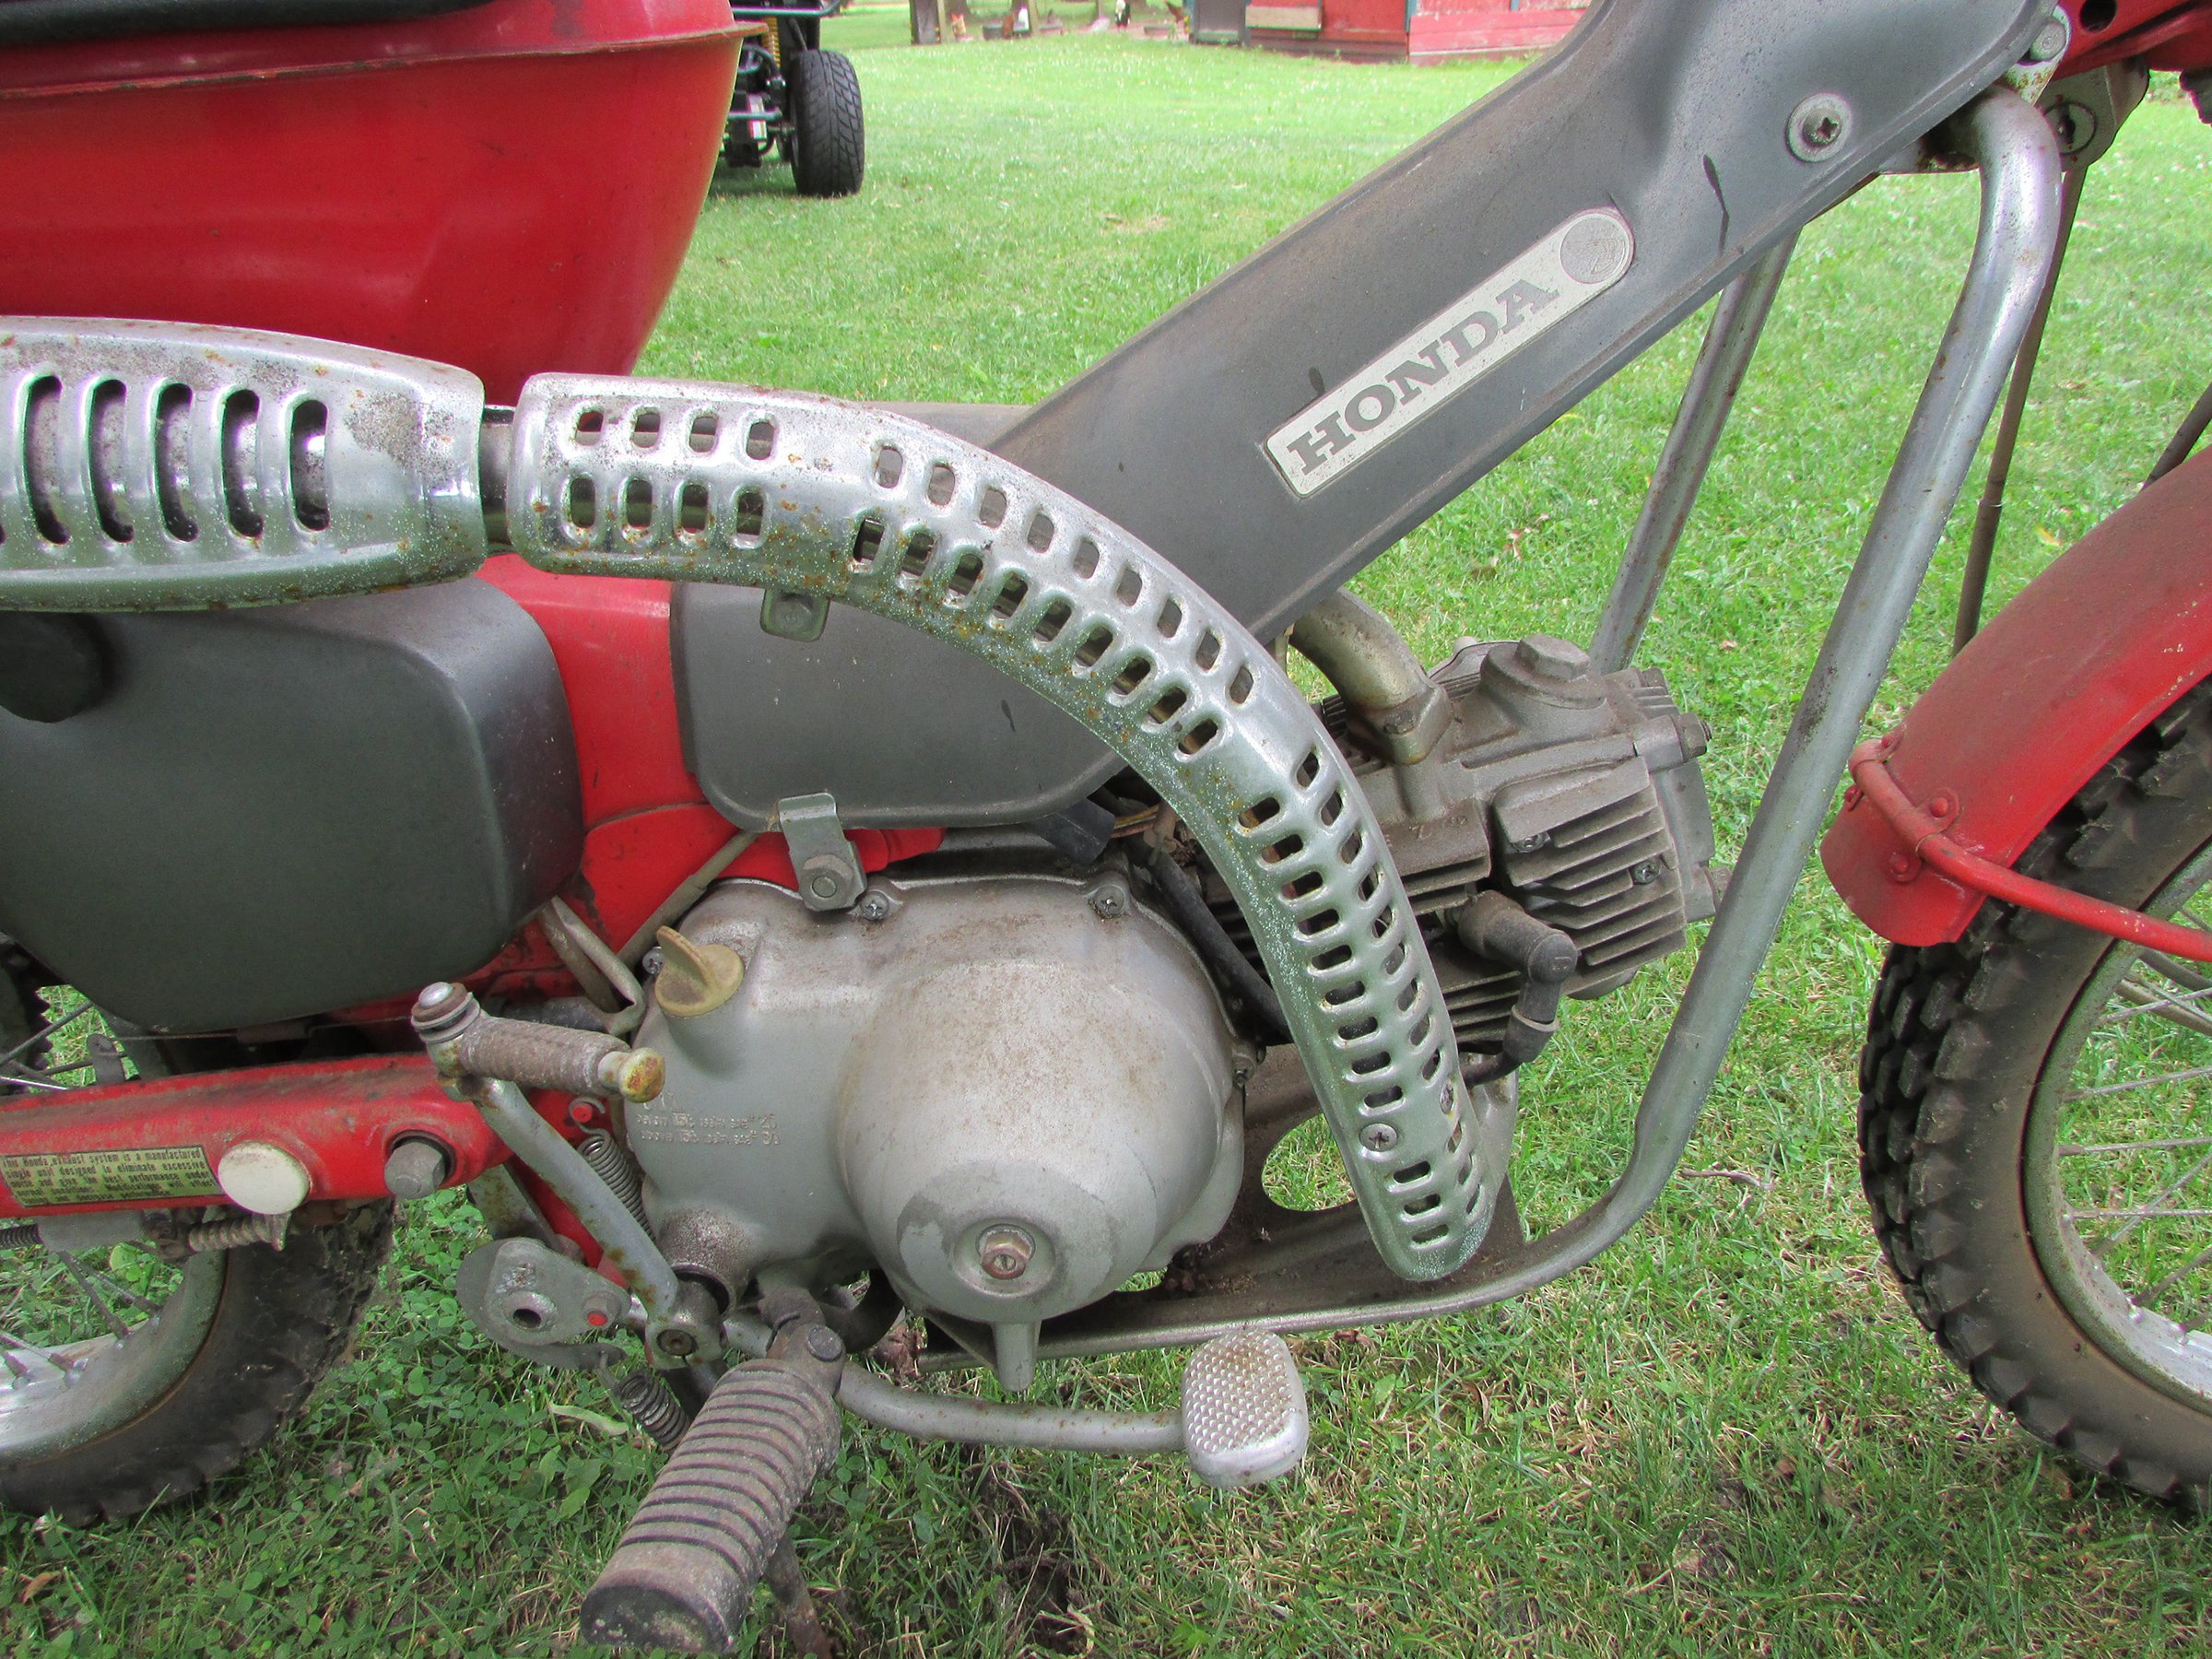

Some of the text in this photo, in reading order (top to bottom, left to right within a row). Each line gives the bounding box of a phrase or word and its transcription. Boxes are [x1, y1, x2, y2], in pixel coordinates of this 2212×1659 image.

[1287, 278, 1559, 476] HONDA
[88, 1152, 119, 1165] system
[145, 1148, 201, 1160] manufactured
[60, 1165, 96, 1177] designed
[118, 1162, 157, 1173] eliminate
[162, 1160, 206, 1171] excessive
